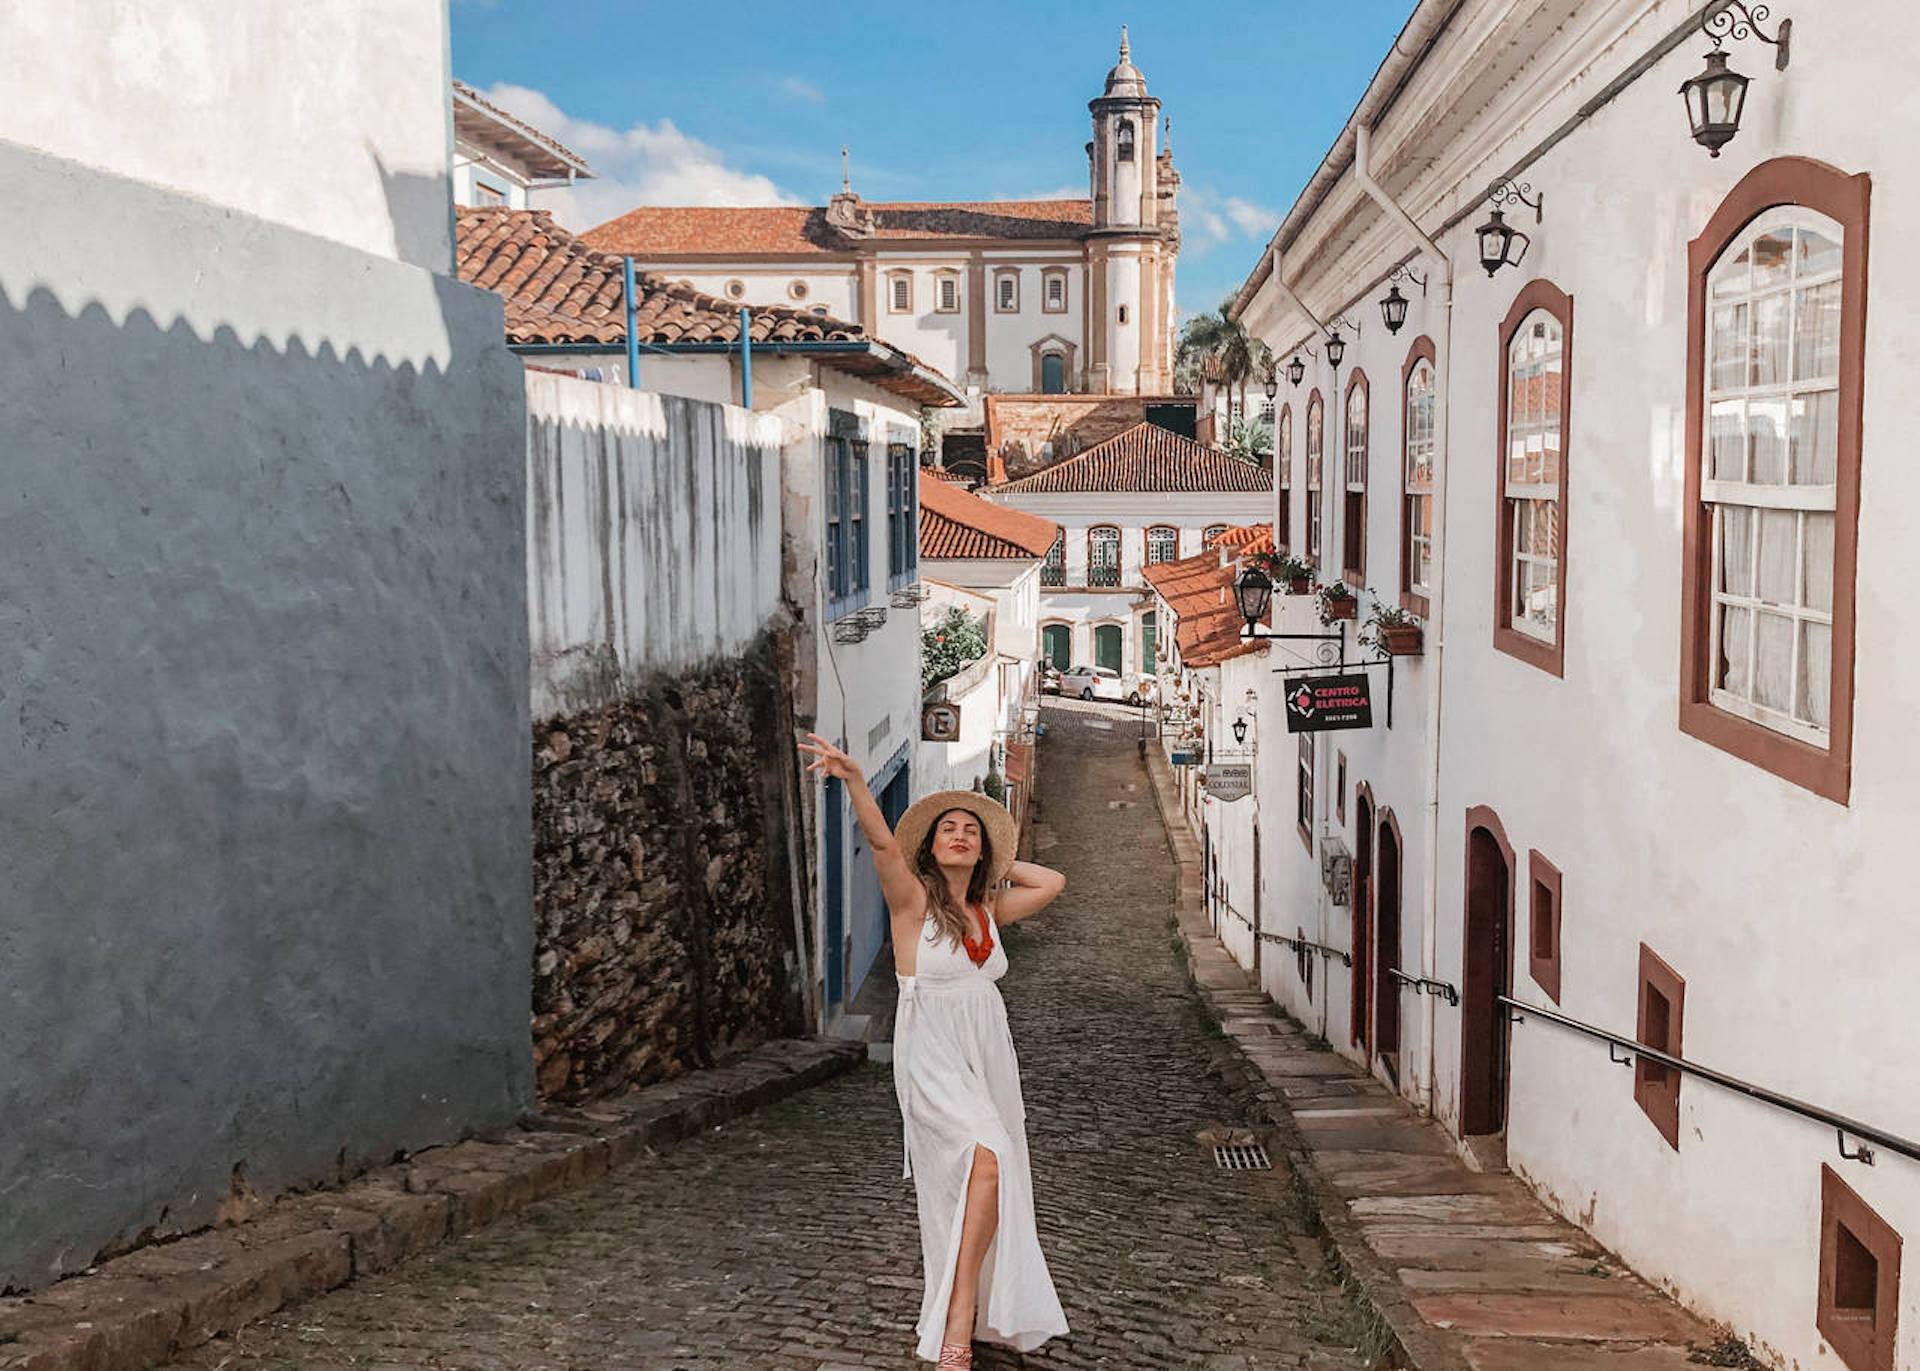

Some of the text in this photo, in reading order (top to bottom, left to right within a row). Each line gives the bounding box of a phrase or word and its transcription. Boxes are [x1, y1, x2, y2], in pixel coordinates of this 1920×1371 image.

[1314, 686, 1361, 698] CENTRO
[935, 712, 949, 734] E
[1208, 780, 1249, 789] COLONIAL
